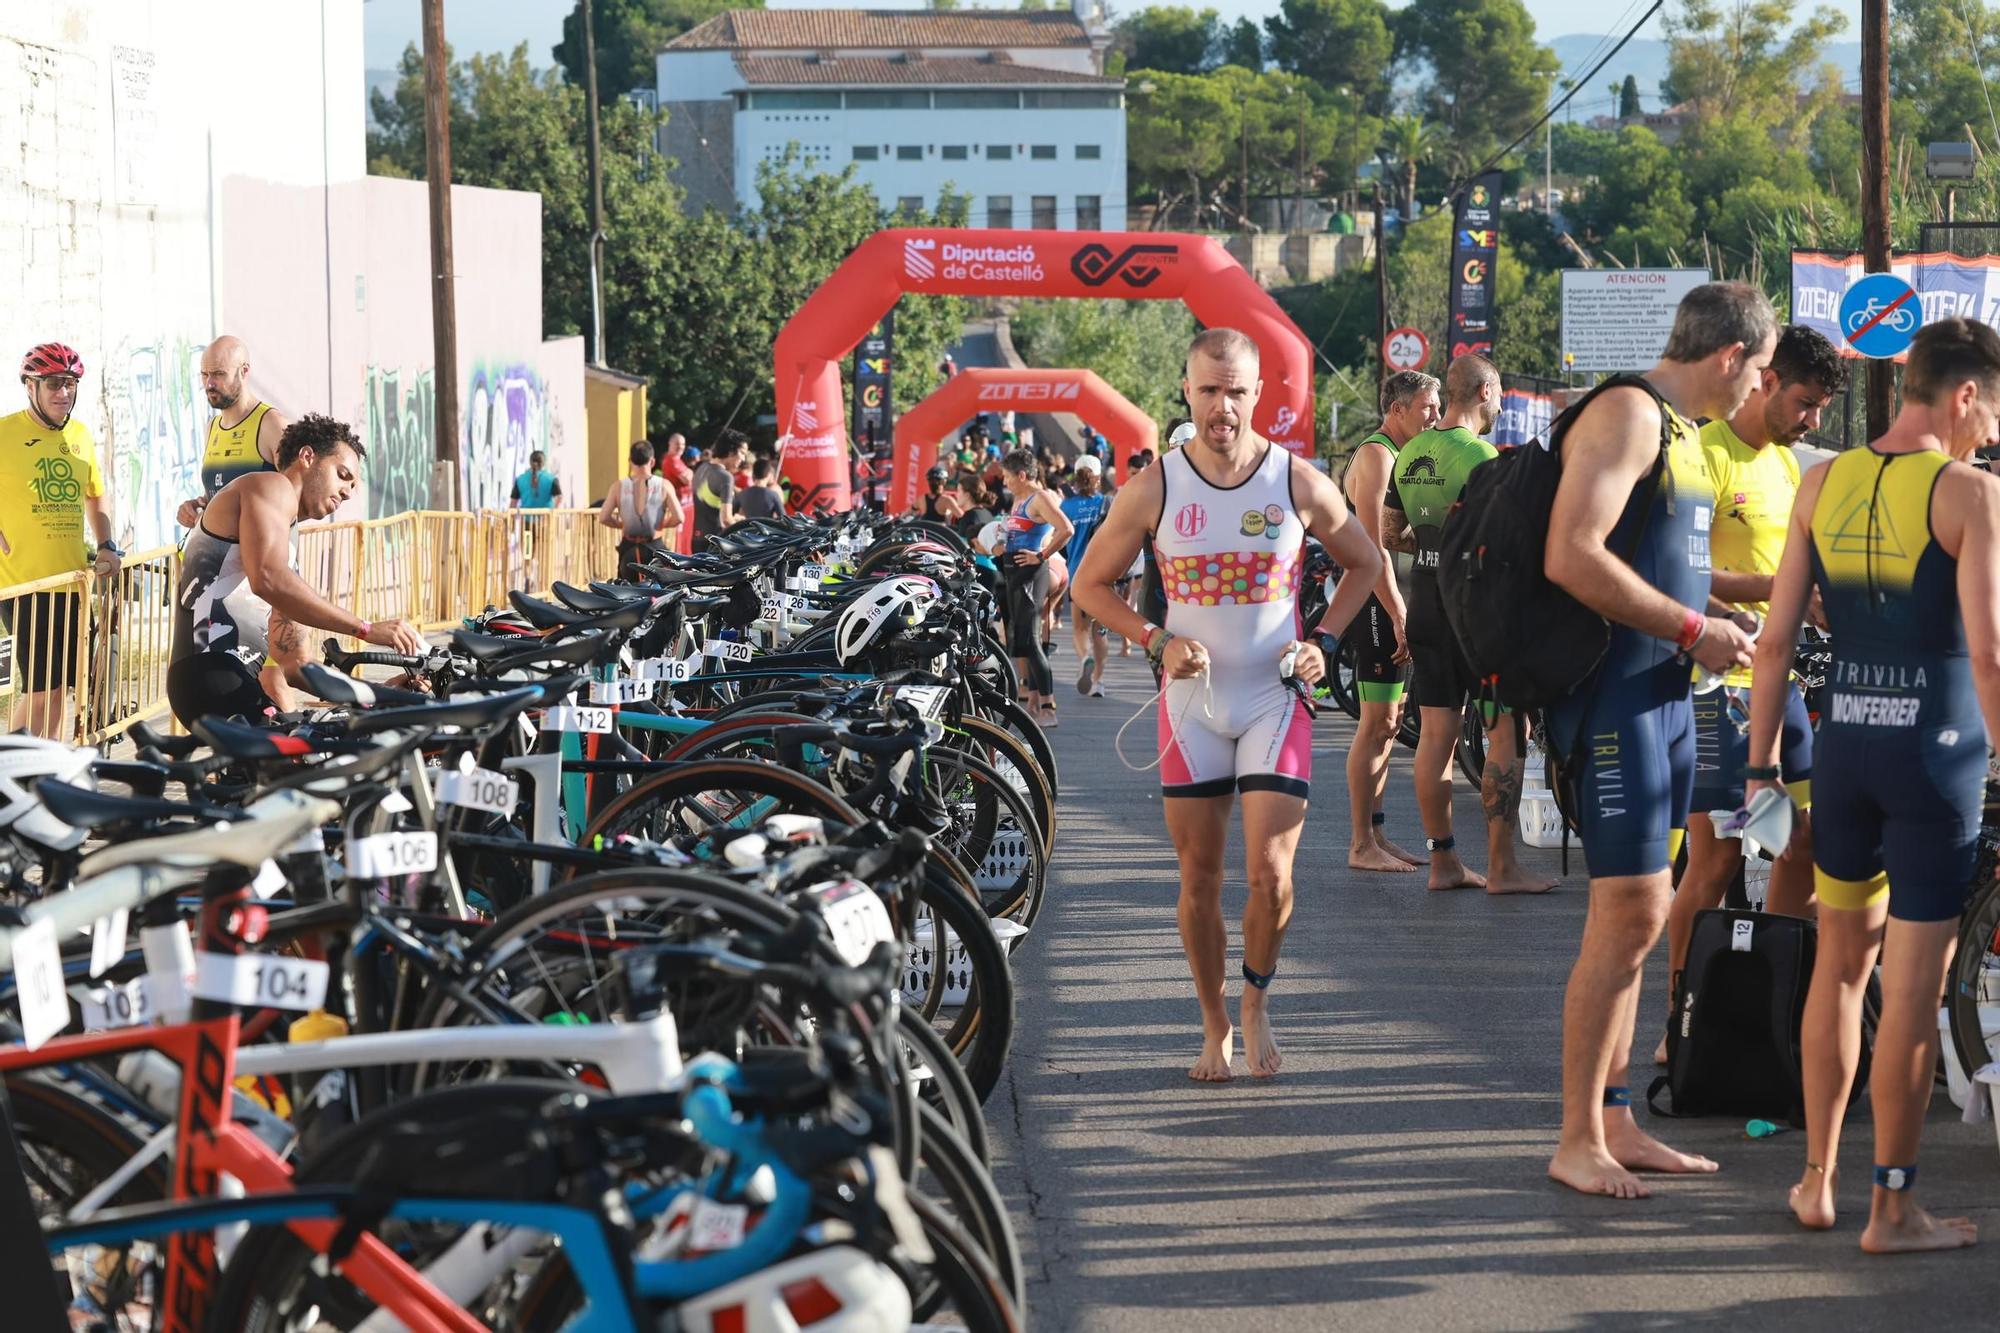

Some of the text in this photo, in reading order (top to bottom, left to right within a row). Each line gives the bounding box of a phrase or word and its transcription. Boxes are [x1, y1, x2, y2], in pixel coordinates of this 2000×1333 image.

[942, 243, 1035, 264] Diputació
[943, 264, 1044, 281] de Castelló
[1606, 273, 1667, 284] ATENCIÓN
[978, 383, 1051, 400] ZONE3
[803, 569, 820, 580] 130
[725, 643, 748, 660] 120
[656, 662, 684, 679] 116
[1835, 660, 1928, 689] TRIVILA
[618, 682, 647, 701] 114
[1831, 692, 1921, 727] MONFERRER
[576, 711, 607, 729] 112
[1592, 731, 1627, 818] TRIVILA
[471, 781, 510, 807] 108
[386, 838, 429, 867] 106
[1736, 922, 1750, 936] 12
[253, 957, 308, 1000] 104
